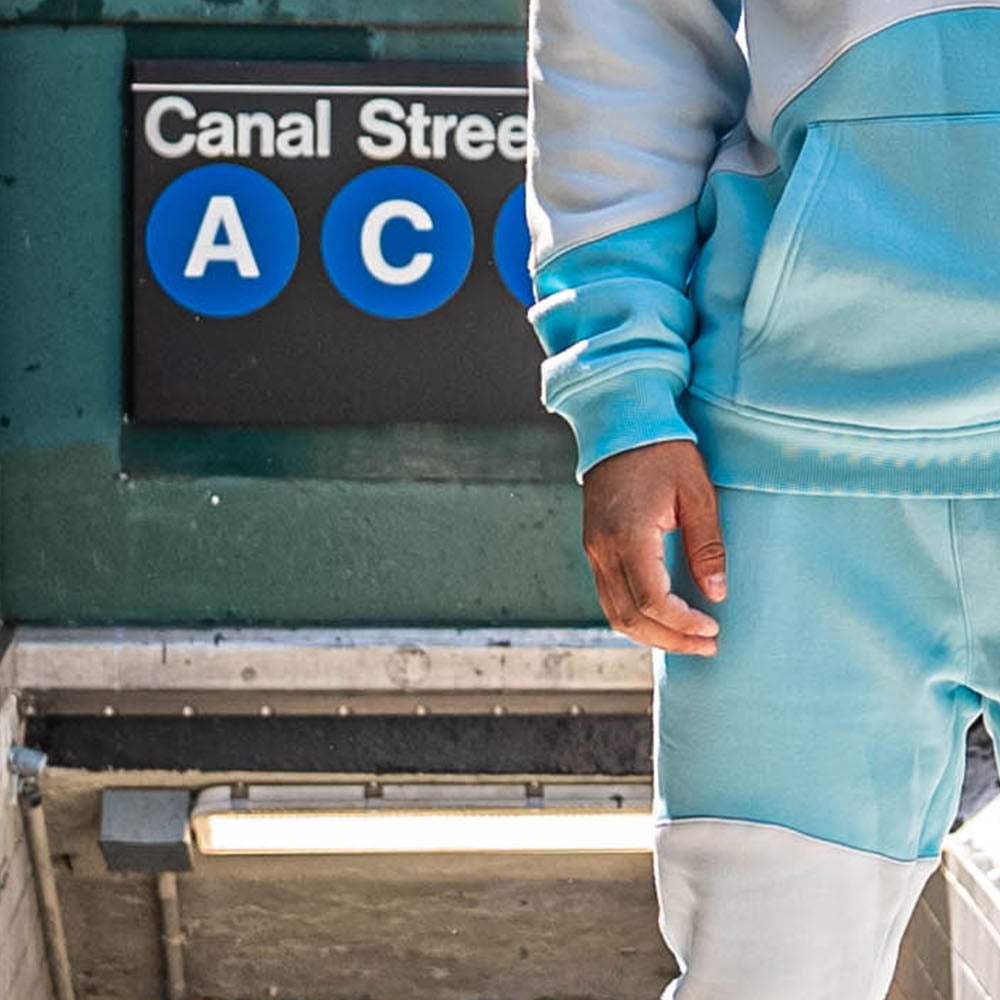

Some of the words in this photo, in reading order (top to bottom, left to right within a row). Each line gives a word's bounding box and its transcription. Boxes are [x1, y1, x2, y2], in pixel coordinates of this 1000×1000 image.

[144, 96, 331, 158] Canal
[357, 98, 528, 160] Stree
[184, 195, 261, 278] A
[360, 199, 433, 285] C
